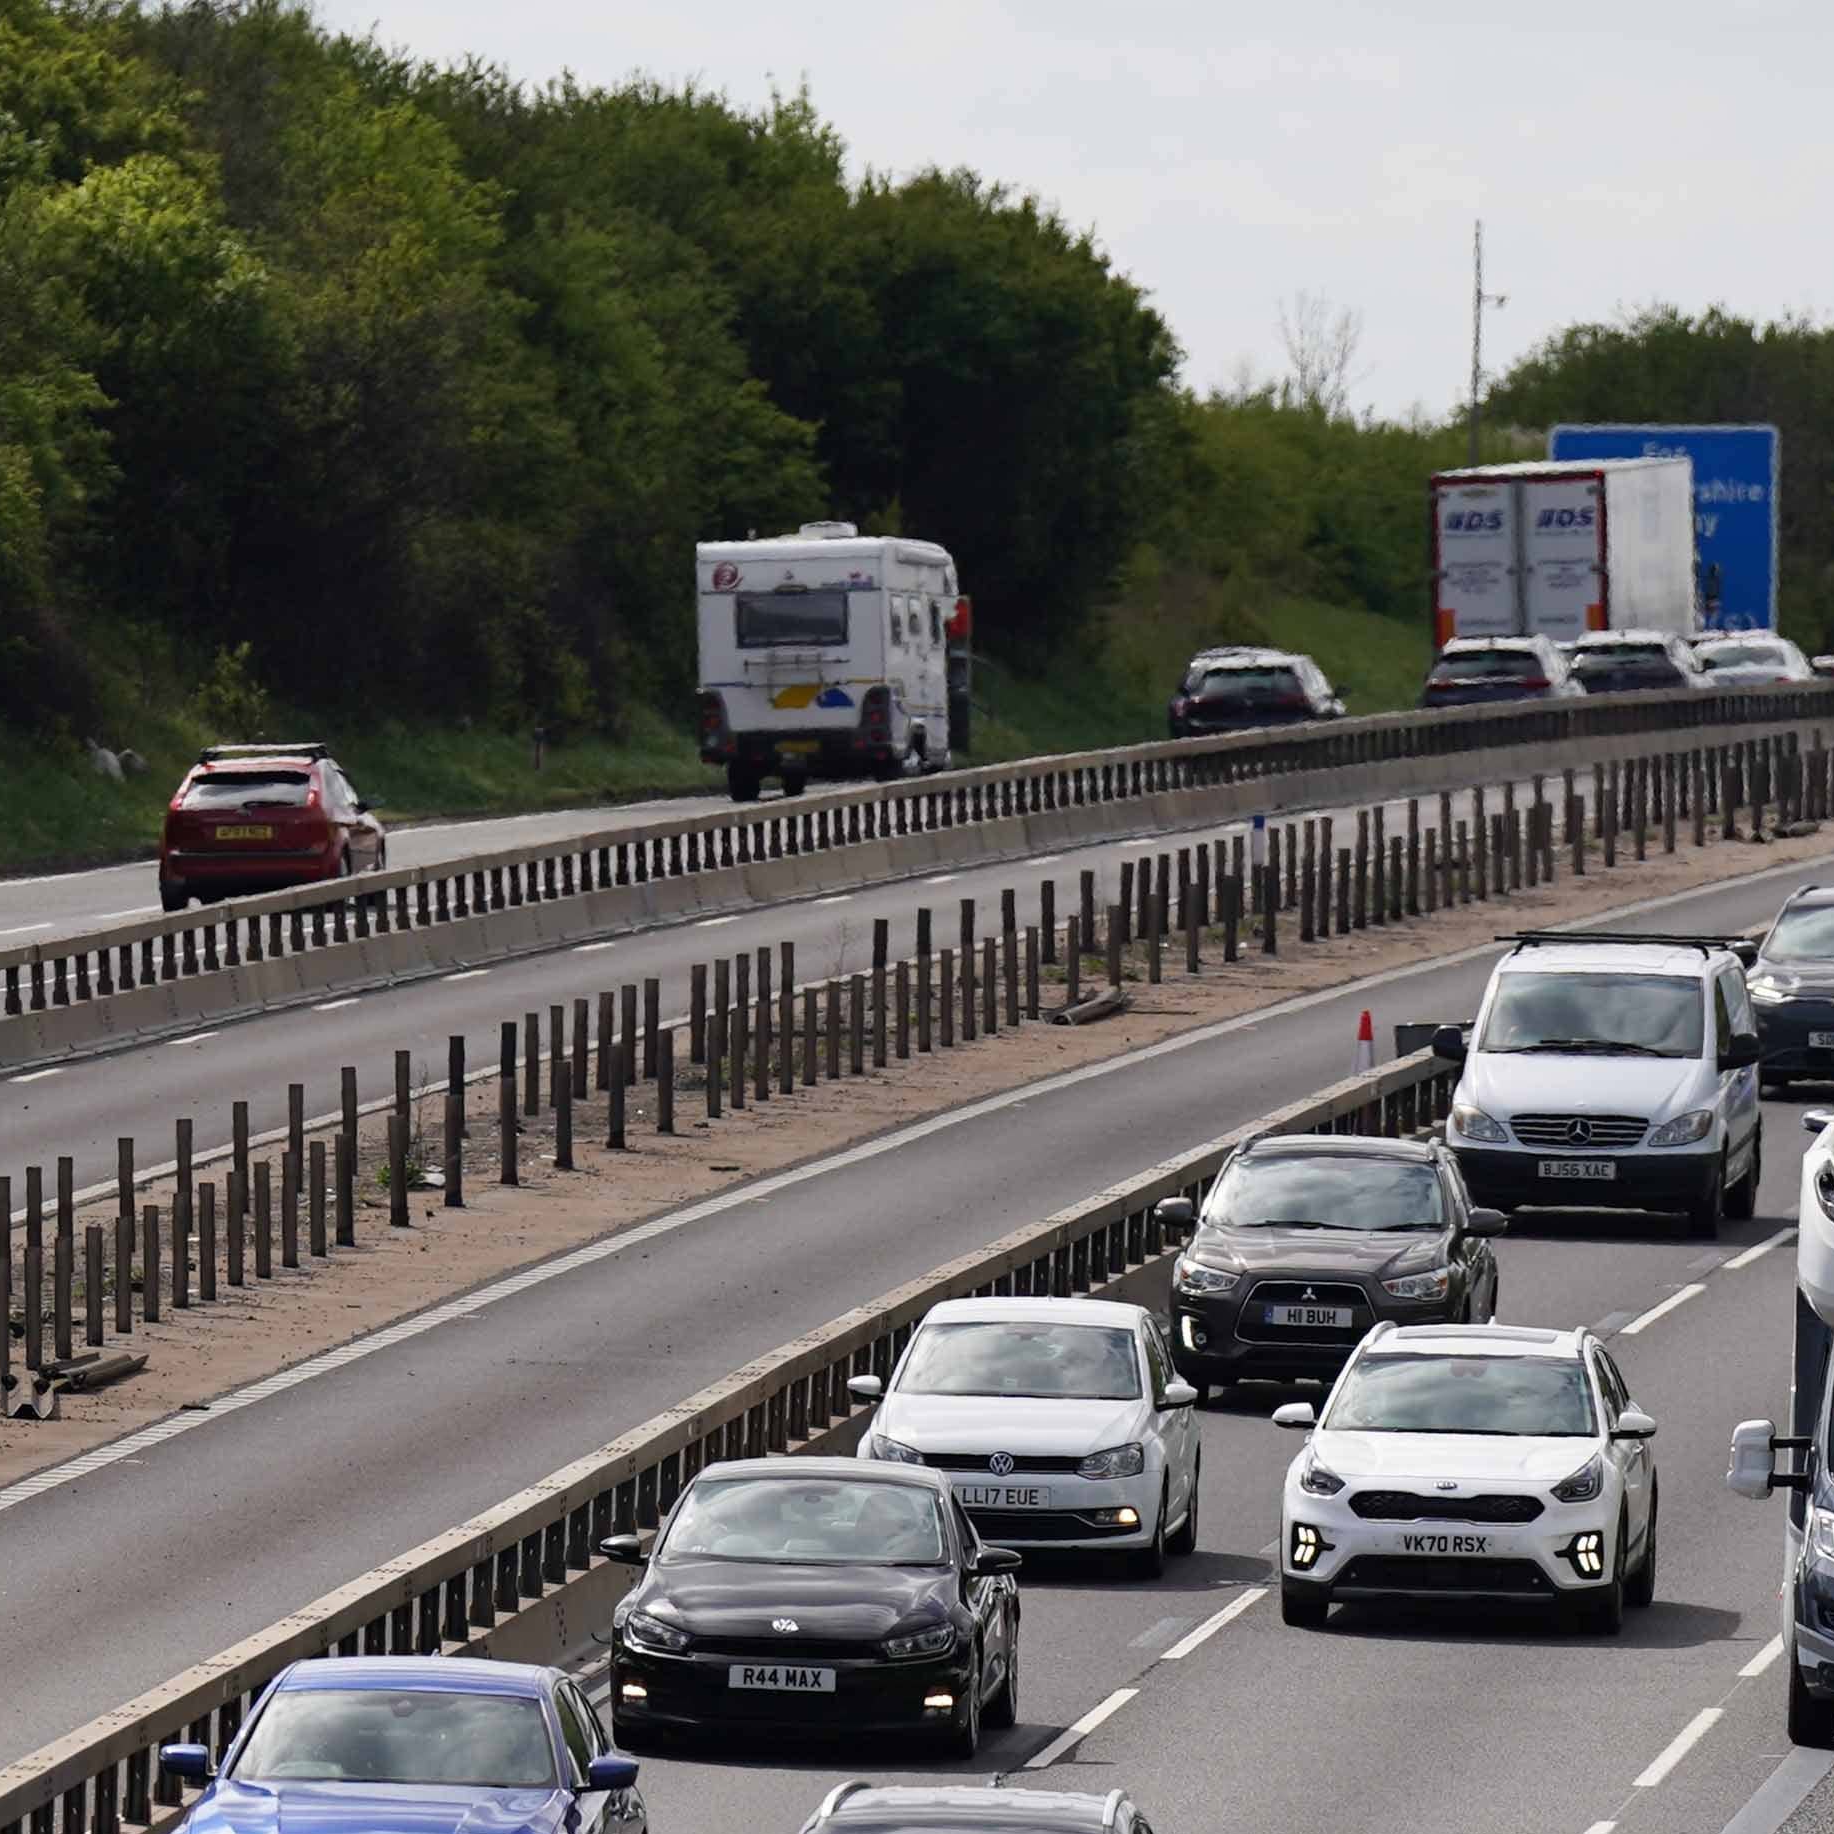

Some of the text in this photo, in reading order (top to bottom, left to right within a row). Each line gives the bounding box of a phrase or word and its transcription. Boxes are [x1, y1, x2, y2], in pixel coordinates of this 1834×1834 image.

[1582, 1163, 1610, 1178] XAE
[1307, 1309, 1337, 1324] BUH
[962, 1487, 1039, 1505] LL17 EUE
[1403, 1535, 1488, 1553] VK70 RSX
[742, 1669, 823, 1689] R44 MAX
